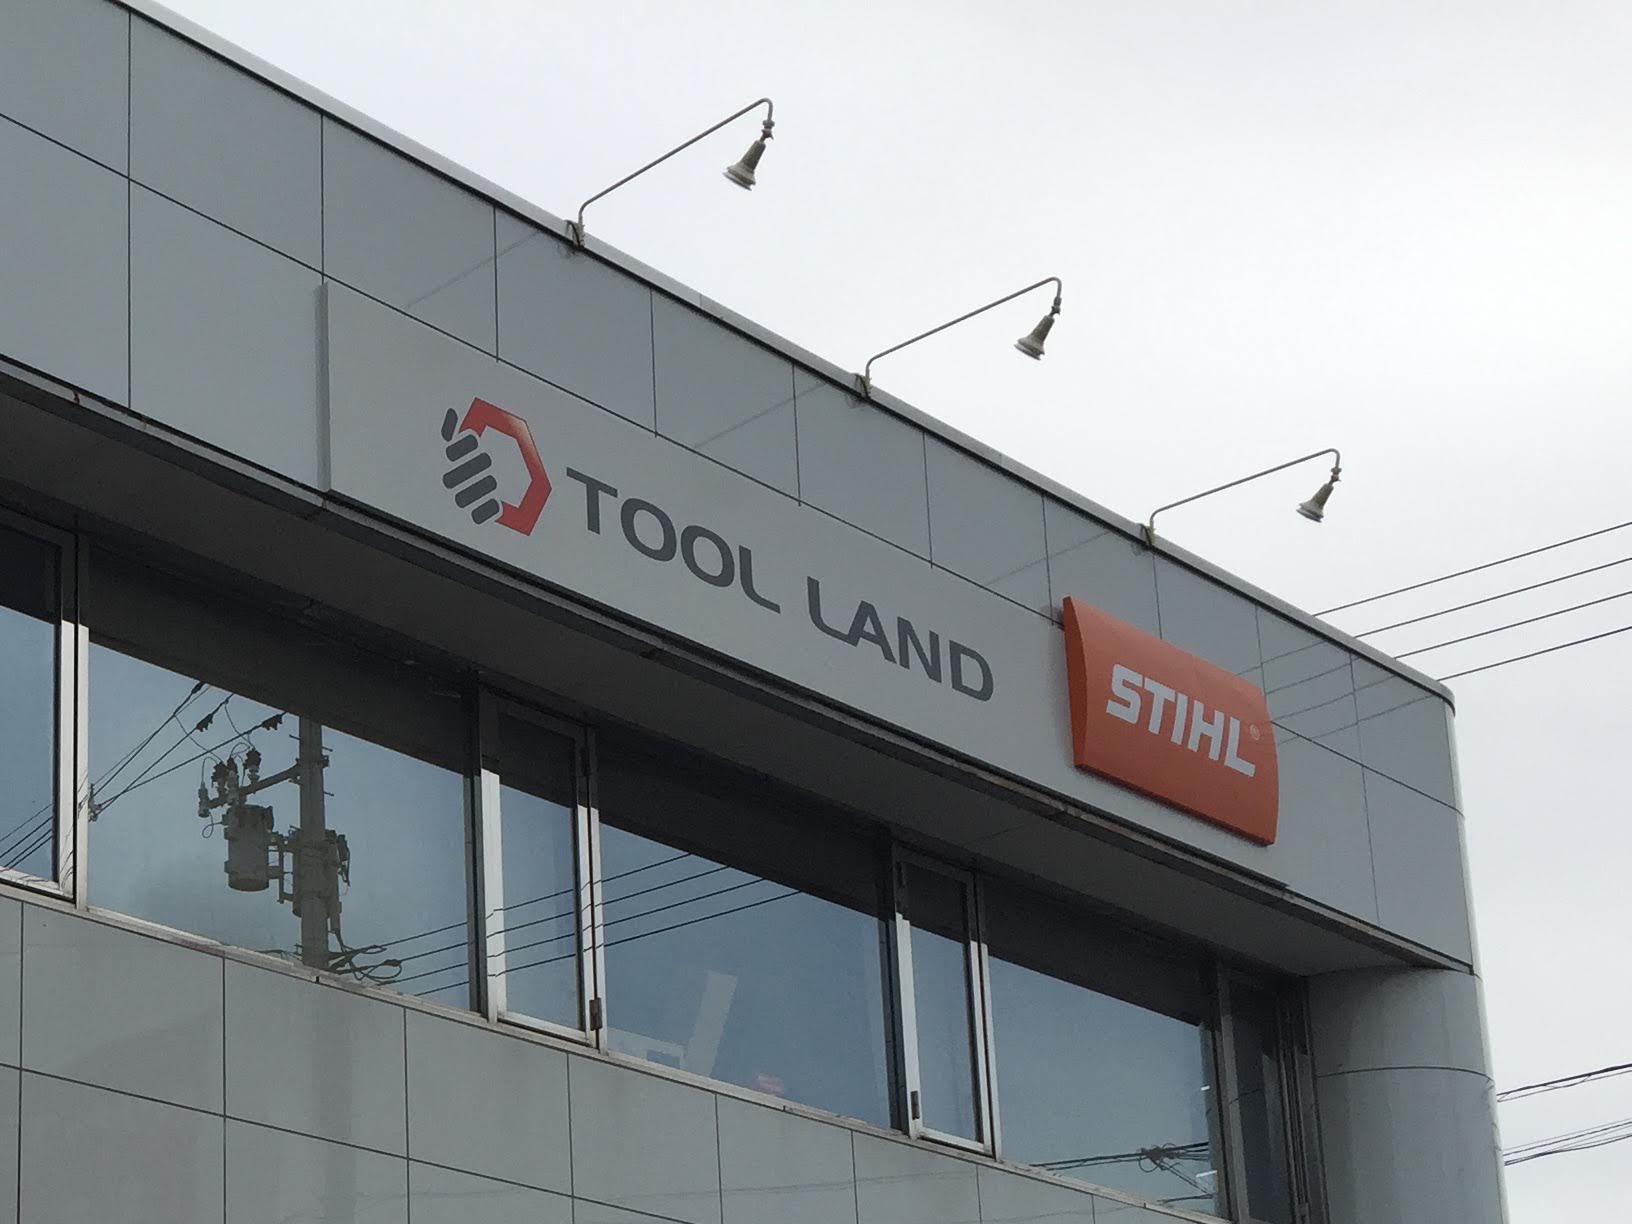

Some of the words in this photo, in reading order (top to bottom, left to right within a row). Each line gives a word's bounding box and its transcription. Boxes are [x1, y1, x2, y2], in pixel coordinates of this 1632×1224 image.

[566, 467, 781, 614] TOOL
[807, 576, 994, 702] LAND
[1106, 664, 1256, 777] STIHL
